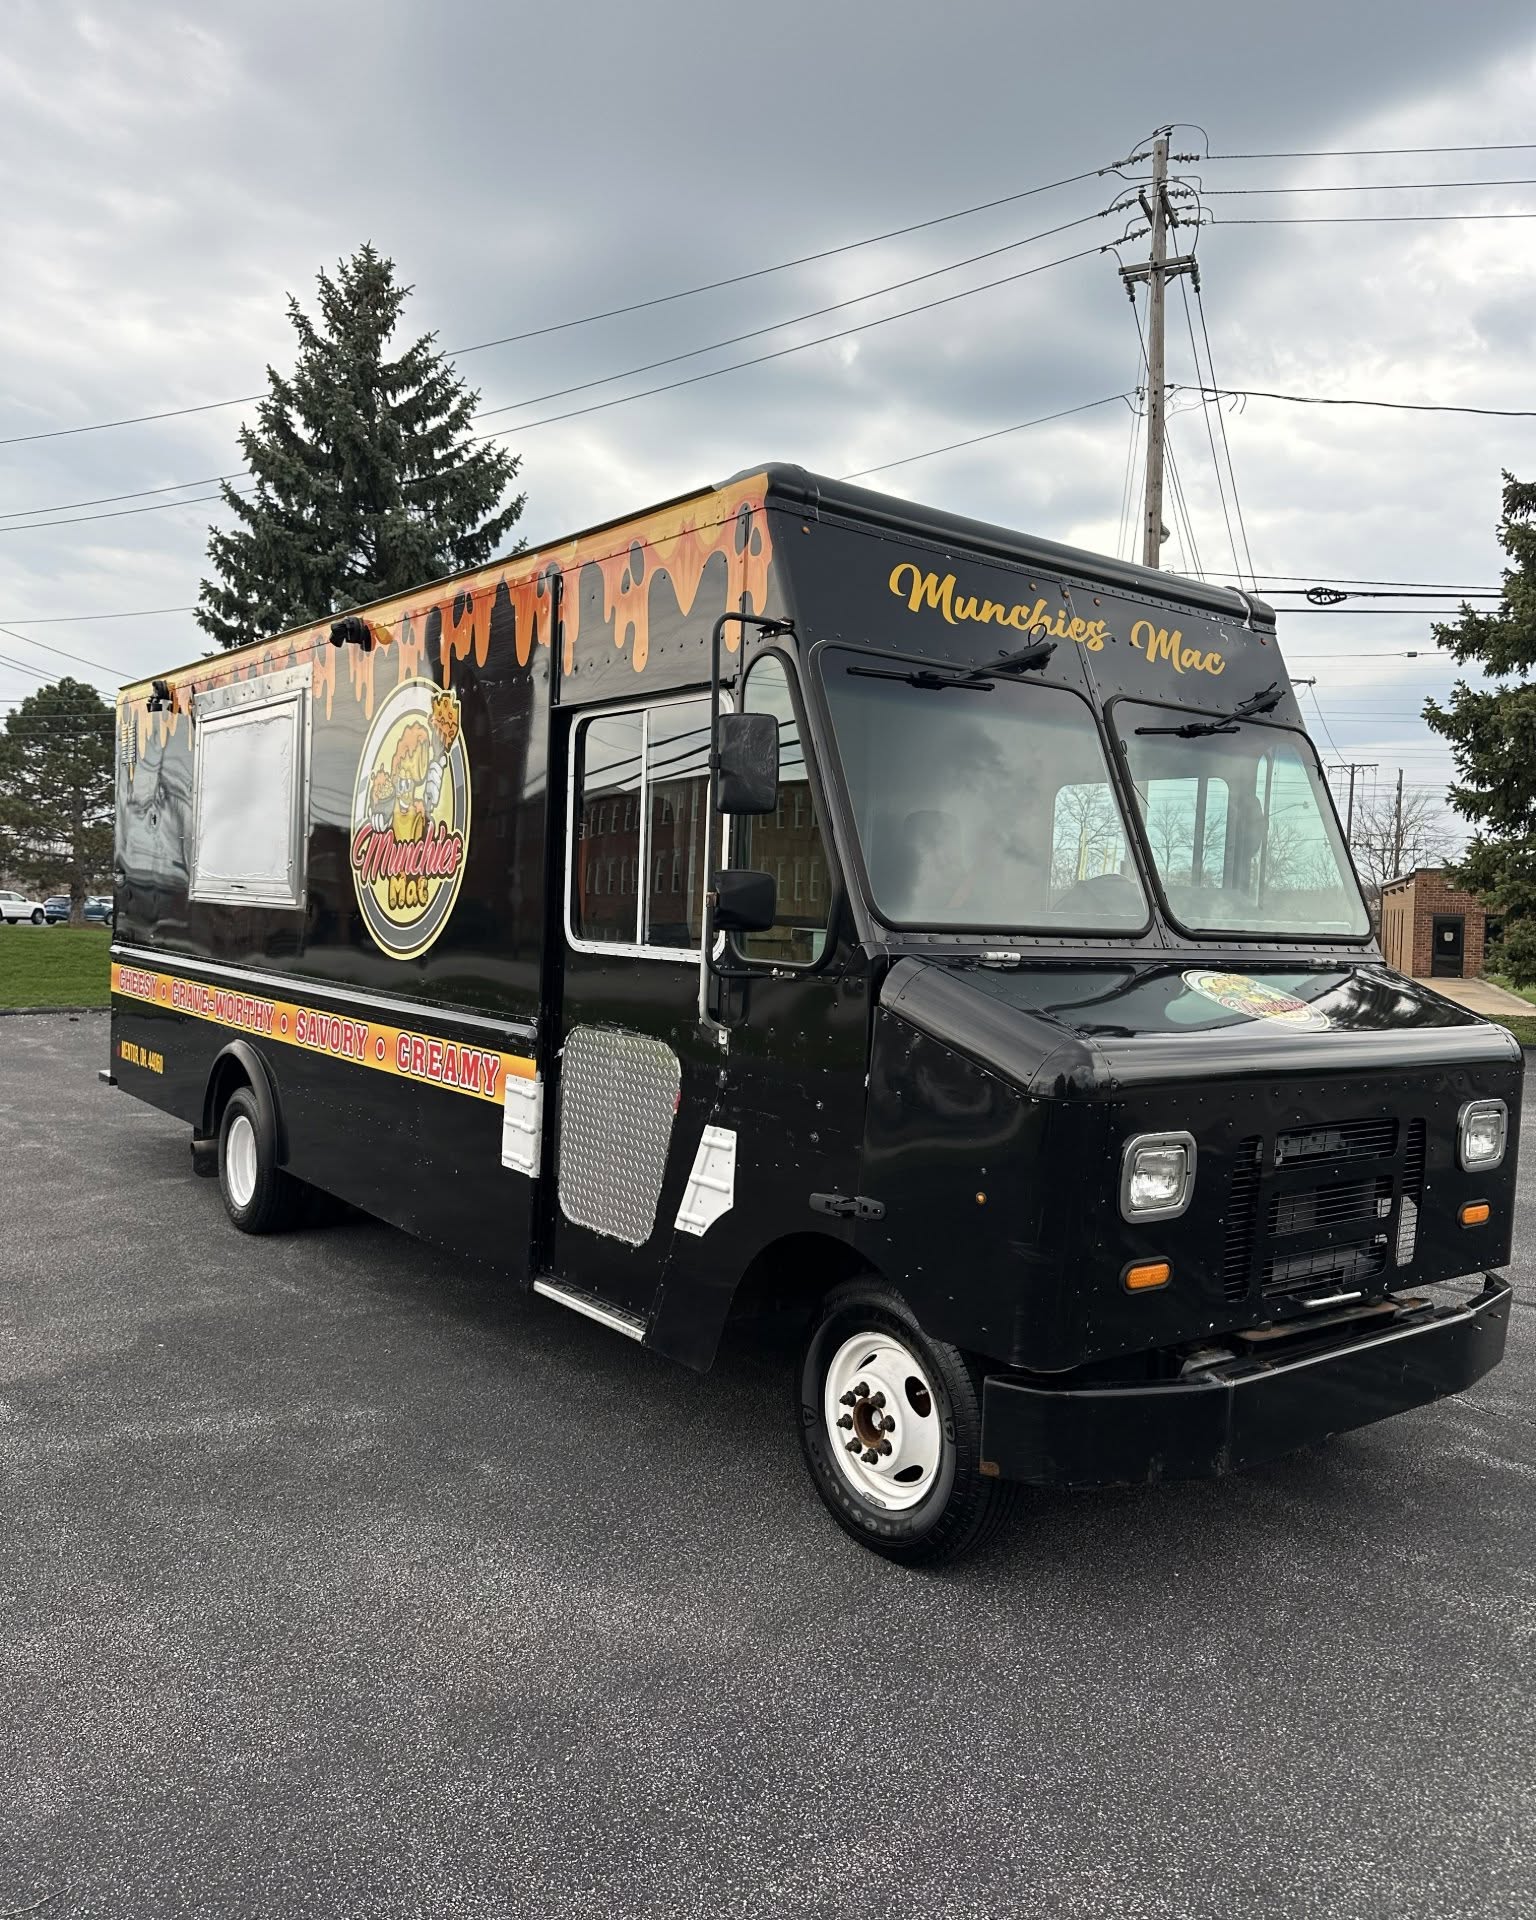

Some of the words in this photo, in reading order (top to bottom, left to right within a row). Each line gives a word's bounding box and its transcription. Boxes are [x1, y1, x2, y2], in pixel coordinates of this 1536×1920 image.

[889, 563, 1112, 651] Munchies
[1130, 620, 1226, 676] Mac
[352, 821, 462, 882] Munchies
[388, 874, 429, 909] Mac
[119, 967, 158, 1001] CHEESY
[171, 979, 276, 1034] CRAVE-WORTHY
[295, 1008, 370, 1060] SAVORY
[396, 1032, 501, 1096] CREAMY
